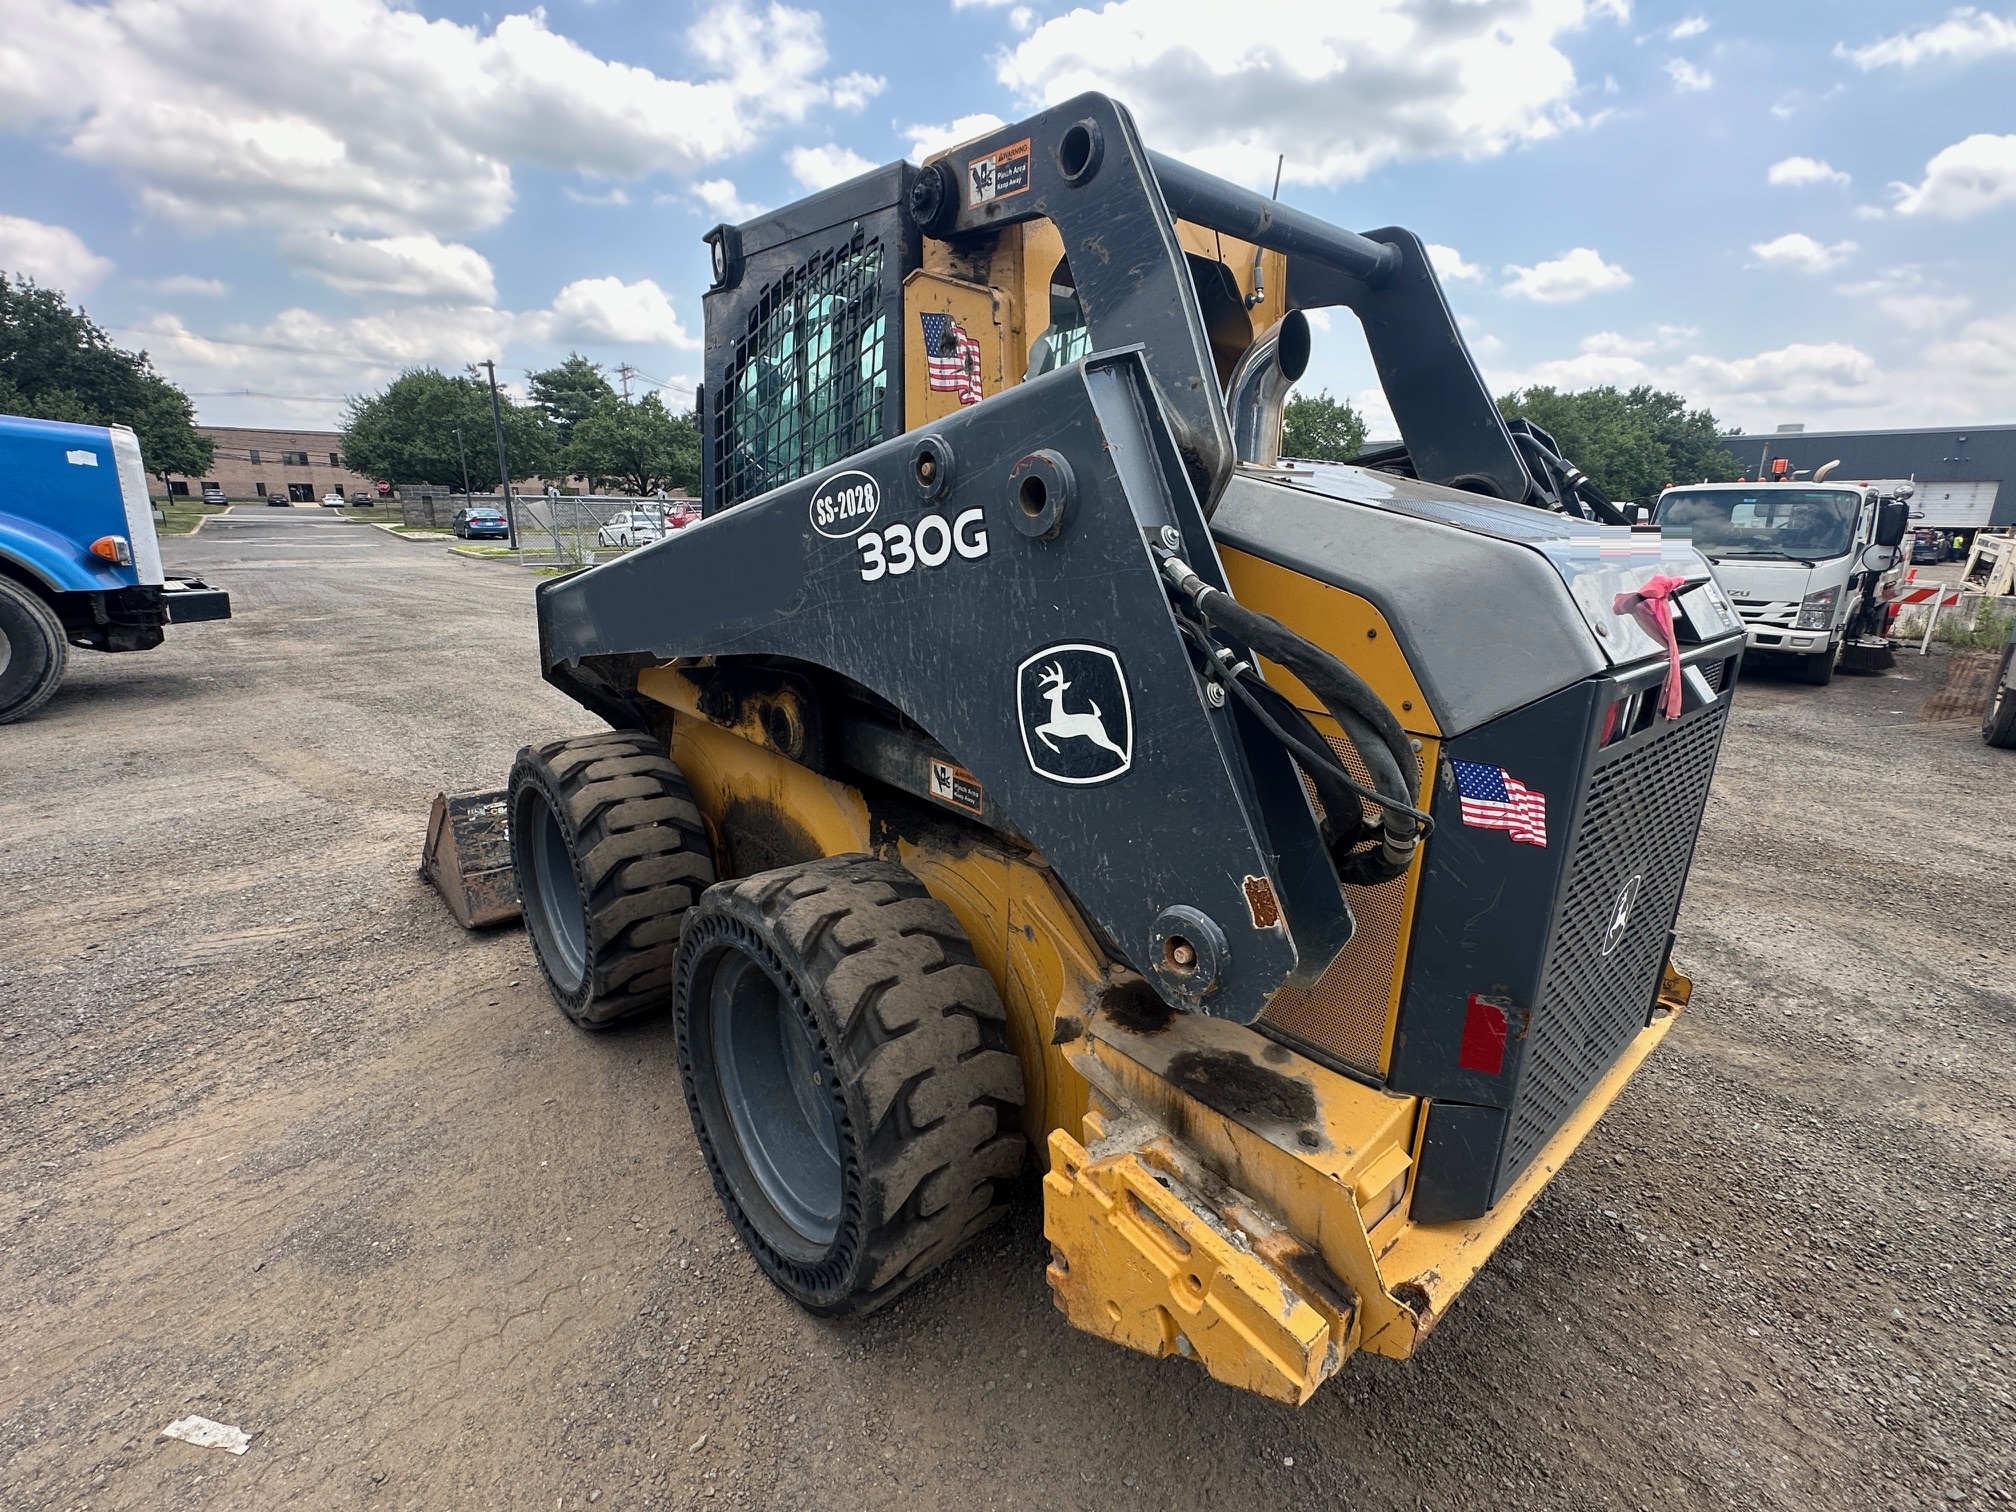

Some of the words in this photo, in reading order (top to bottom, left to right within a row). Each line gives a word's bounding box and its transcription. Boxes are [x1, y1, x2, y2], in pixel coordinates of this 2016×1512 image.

[1003, 144, 1028, 160] WARNING
[997, 168, 1013, 181] Pinch
[1013, 164, 1027, 175] Area
[997, 181, 1009, 190] Keep
[1009, 177, 1022, 186] Away
[816, 482, 875, 526] SS-2028
[857, 508, 988, 582] 330G
